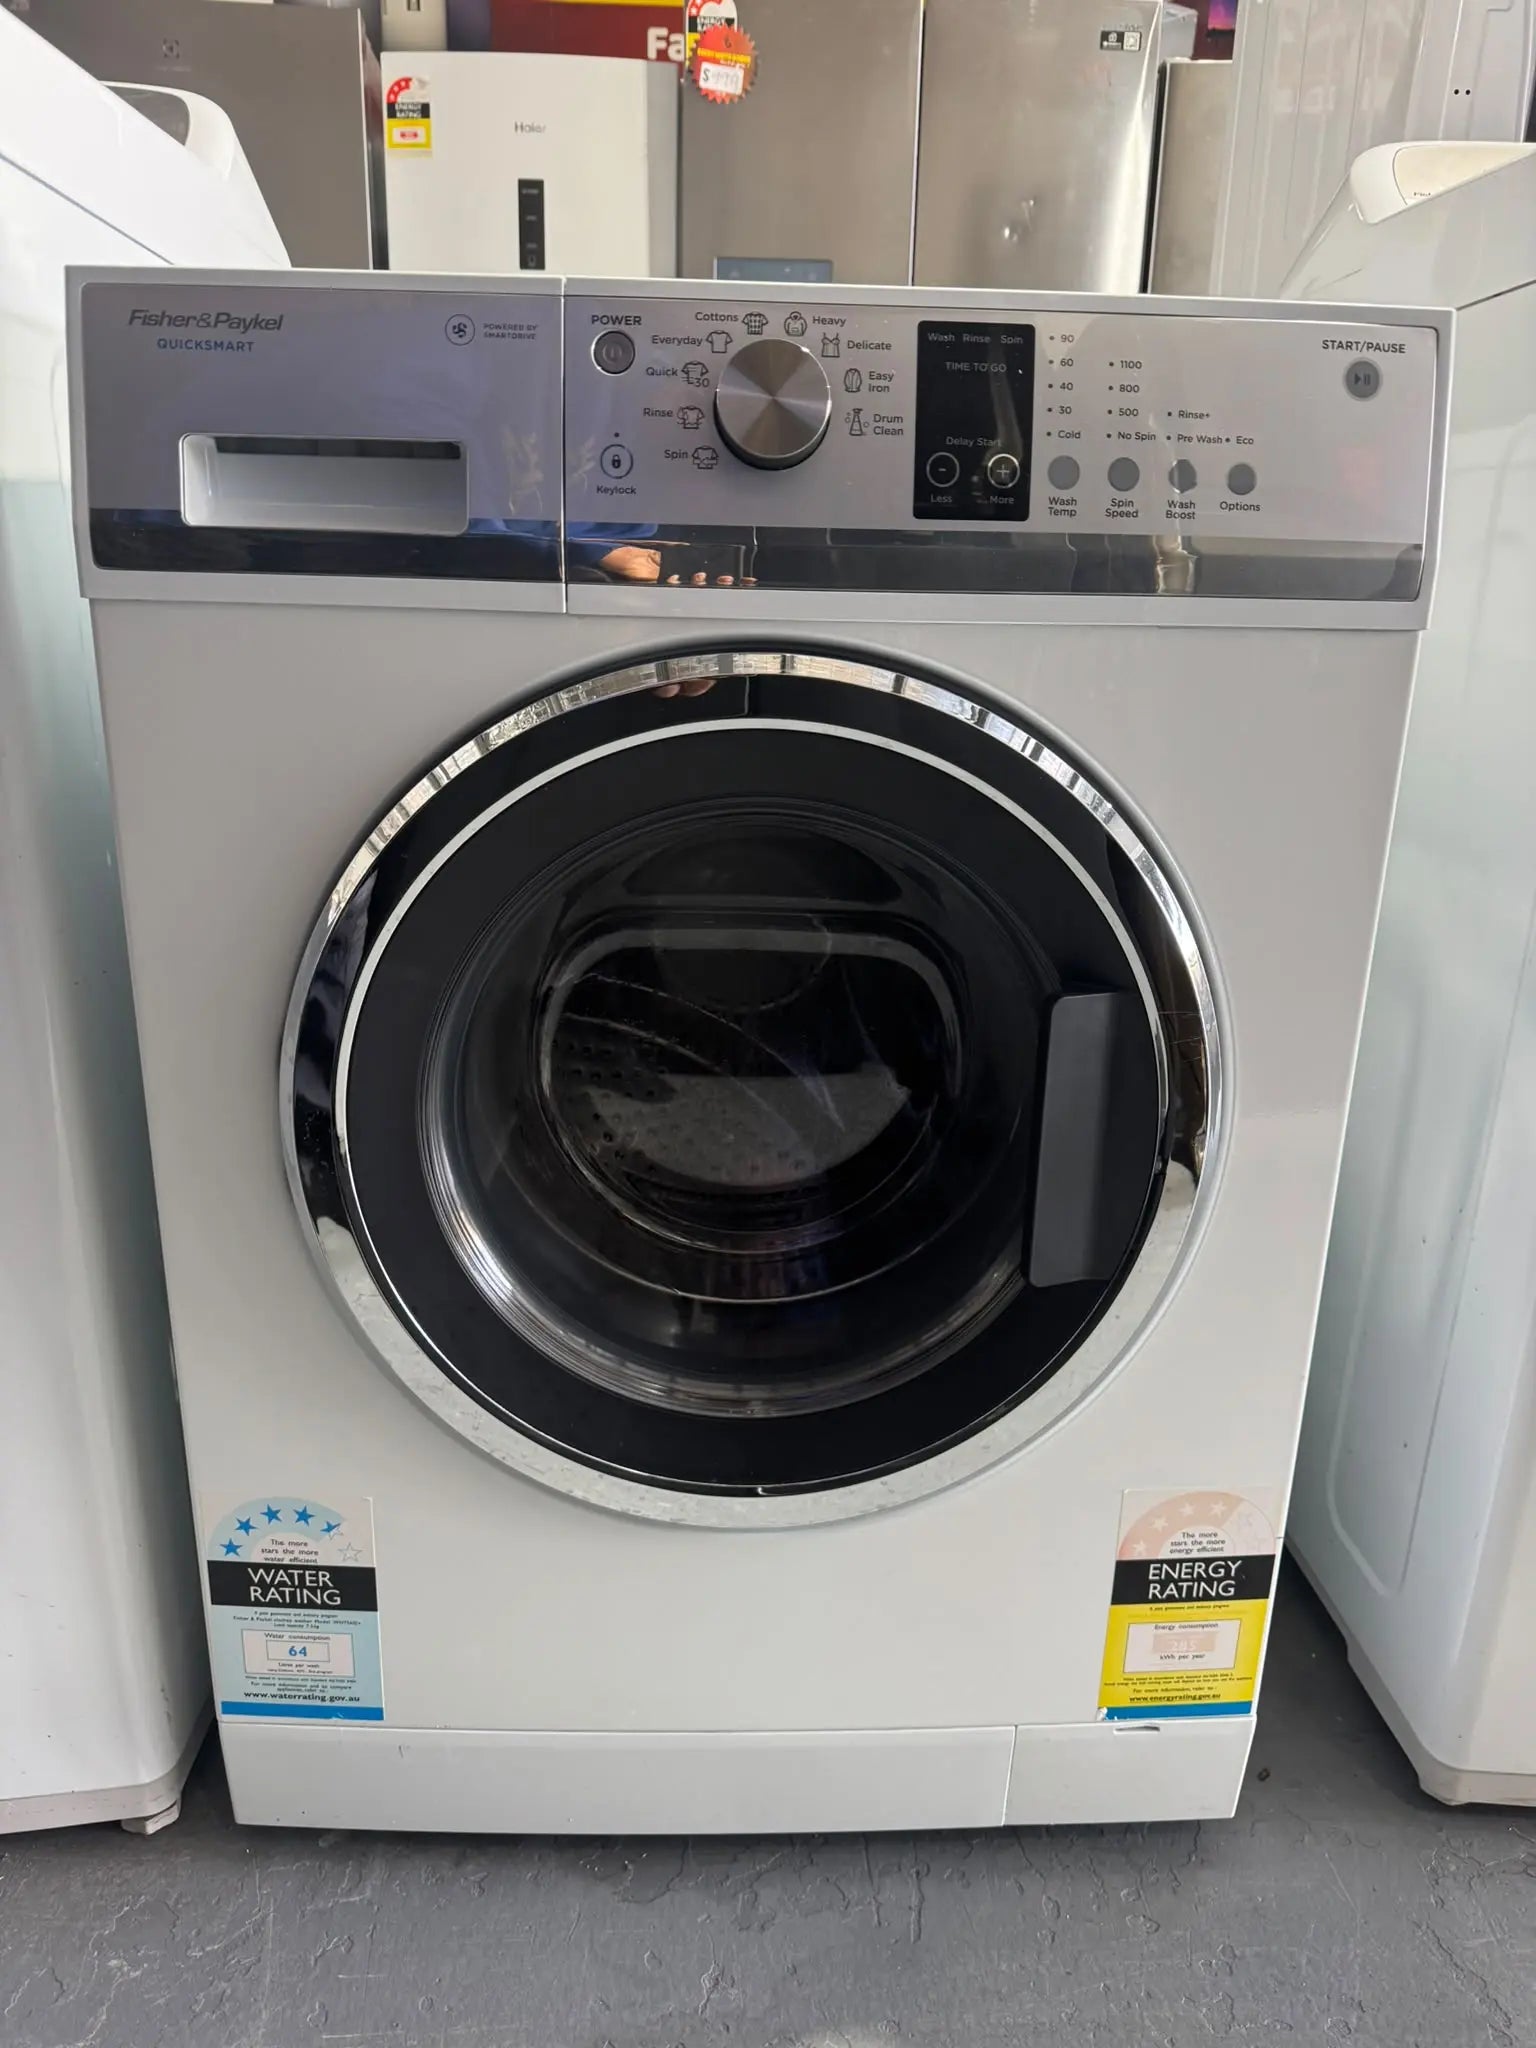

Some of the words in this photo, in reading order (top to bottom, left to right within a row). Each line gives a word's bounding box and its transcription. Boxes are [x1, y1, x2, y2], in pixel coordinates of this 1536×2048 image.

[514, 121, 546, 133] Haier
[128, 309, 284, 334] Fisher&Paykel
[591, 315, 642, 325] POWER
[695, 312, 739, 322] Cottons
[812, 316, 847, 327] Heavy
[483, 323, 524, 331] POWERED
[483, 332, 537, 340] SMARTDRIVE
[651, 335, 703, 347] Everyday
[928, 333, 955, 342] Wash
[962, 333, 991, 343] Rinse
[1000, 335, 1023, 345] Spin
[1060, 334, 1075, 343] 90
[157, 338, 256, 352] QUICKSMART
[847, 340, 892, 350] Delicate
[1322, 339, 1406, 354] START/PAUSE
[944, 361, 971, 371] TIME
[973, 362, 988, 372] TO
[990, 363, 1007, 373] GO
[1060, 358, 1074, 367] 60
[1120, 360, 1142, 369] 1100
[646, 367, 678, 377] Quick
[868, 371, 894, 382] Easy
[694, 378, 710, 388] 30
[868, 383, 890, 393] Iron
[1059, 382, 1074, 391] 40
[1119, 384, 1140, 393] 800
[643, 407, 673, 417] Rinse
[1058, 406, 1072, 415] 30
[1118, 408, 1139, 417] 500
[1178, 410, 1210, 419] Rinse+
[873, 414, 903, 423] Drum
[873, 426, 904, 435] Clean
[1058, 430, 1081, 439] Cold
[945, 436, 975, 447] Delay
[976, 437, 1002, 447] Start
[1117, 431, 1133, 440] No
[1134, 432, 1156, 443] Spin
[1177, 434, 1194, 444] Pre
[1196, 435, 1223, 444] Wash
[1236, 436, 1255, 445] Eco
[664, 449, 688, 460] Spin
[596, 485, 637, 495] Keylock
[930, 494, 953, 503] Less
[989, 496, 1015, 504] More
[1048, 497, 1078, 506] Wash
[1110, 498, 1135, 508] Spin
[1167, 500, 1196, 509] Wash
[1219, 501, 1261, 512] Options
[1048, 507, 1078, 518] Temp
[1105, 508, 1139, 519] Speed
[1165, 510, 1196, 520] Boost
[1169, 1547, 1194, 1555] energy
[1148, 1560, 1242, 1580] ENERGY
[248, 1567, 334, 1588] WATER
[1148, 1580, 1236, 1600] RATING
[250, 1586, 342, 1605] RATING
[264, 1632, 285, 1640] Water
[288, 1645, 308, 1657] 64
[244, 1690, 360, 1702] www.waterrating.gov.au
